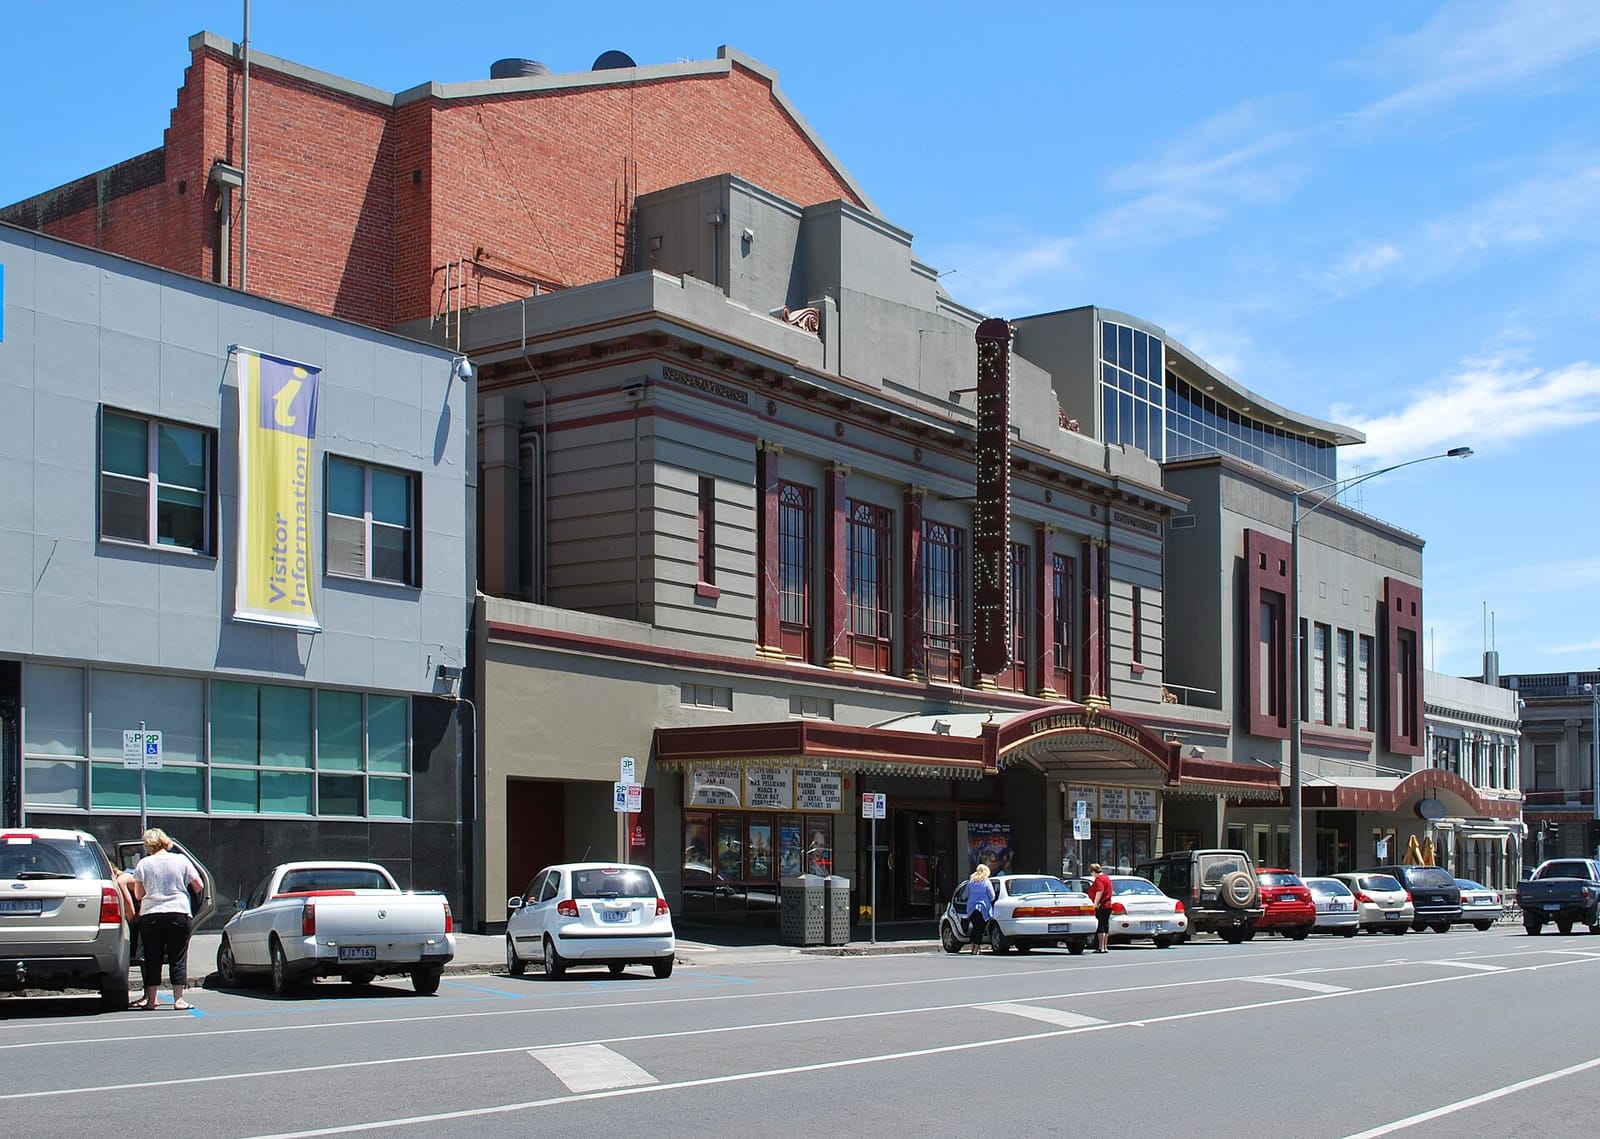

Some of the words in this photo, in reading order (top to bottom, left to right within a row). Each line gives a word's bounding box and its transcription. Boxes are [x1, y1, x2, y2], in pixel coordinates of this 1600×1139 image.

[978, 341, 1000, 643] REGENT
[291, 446, 307, 607] Information
[269, 512, 288, 604] Visitor
[146, 734, 159, 744] 2P
[1030, 718, 1048, 734] THE
[1050, 714, 1082, 729] REGENT
[1100, 716, 1140, 743] MULTIPLEX
[616, 785, 627, 793] 2P
